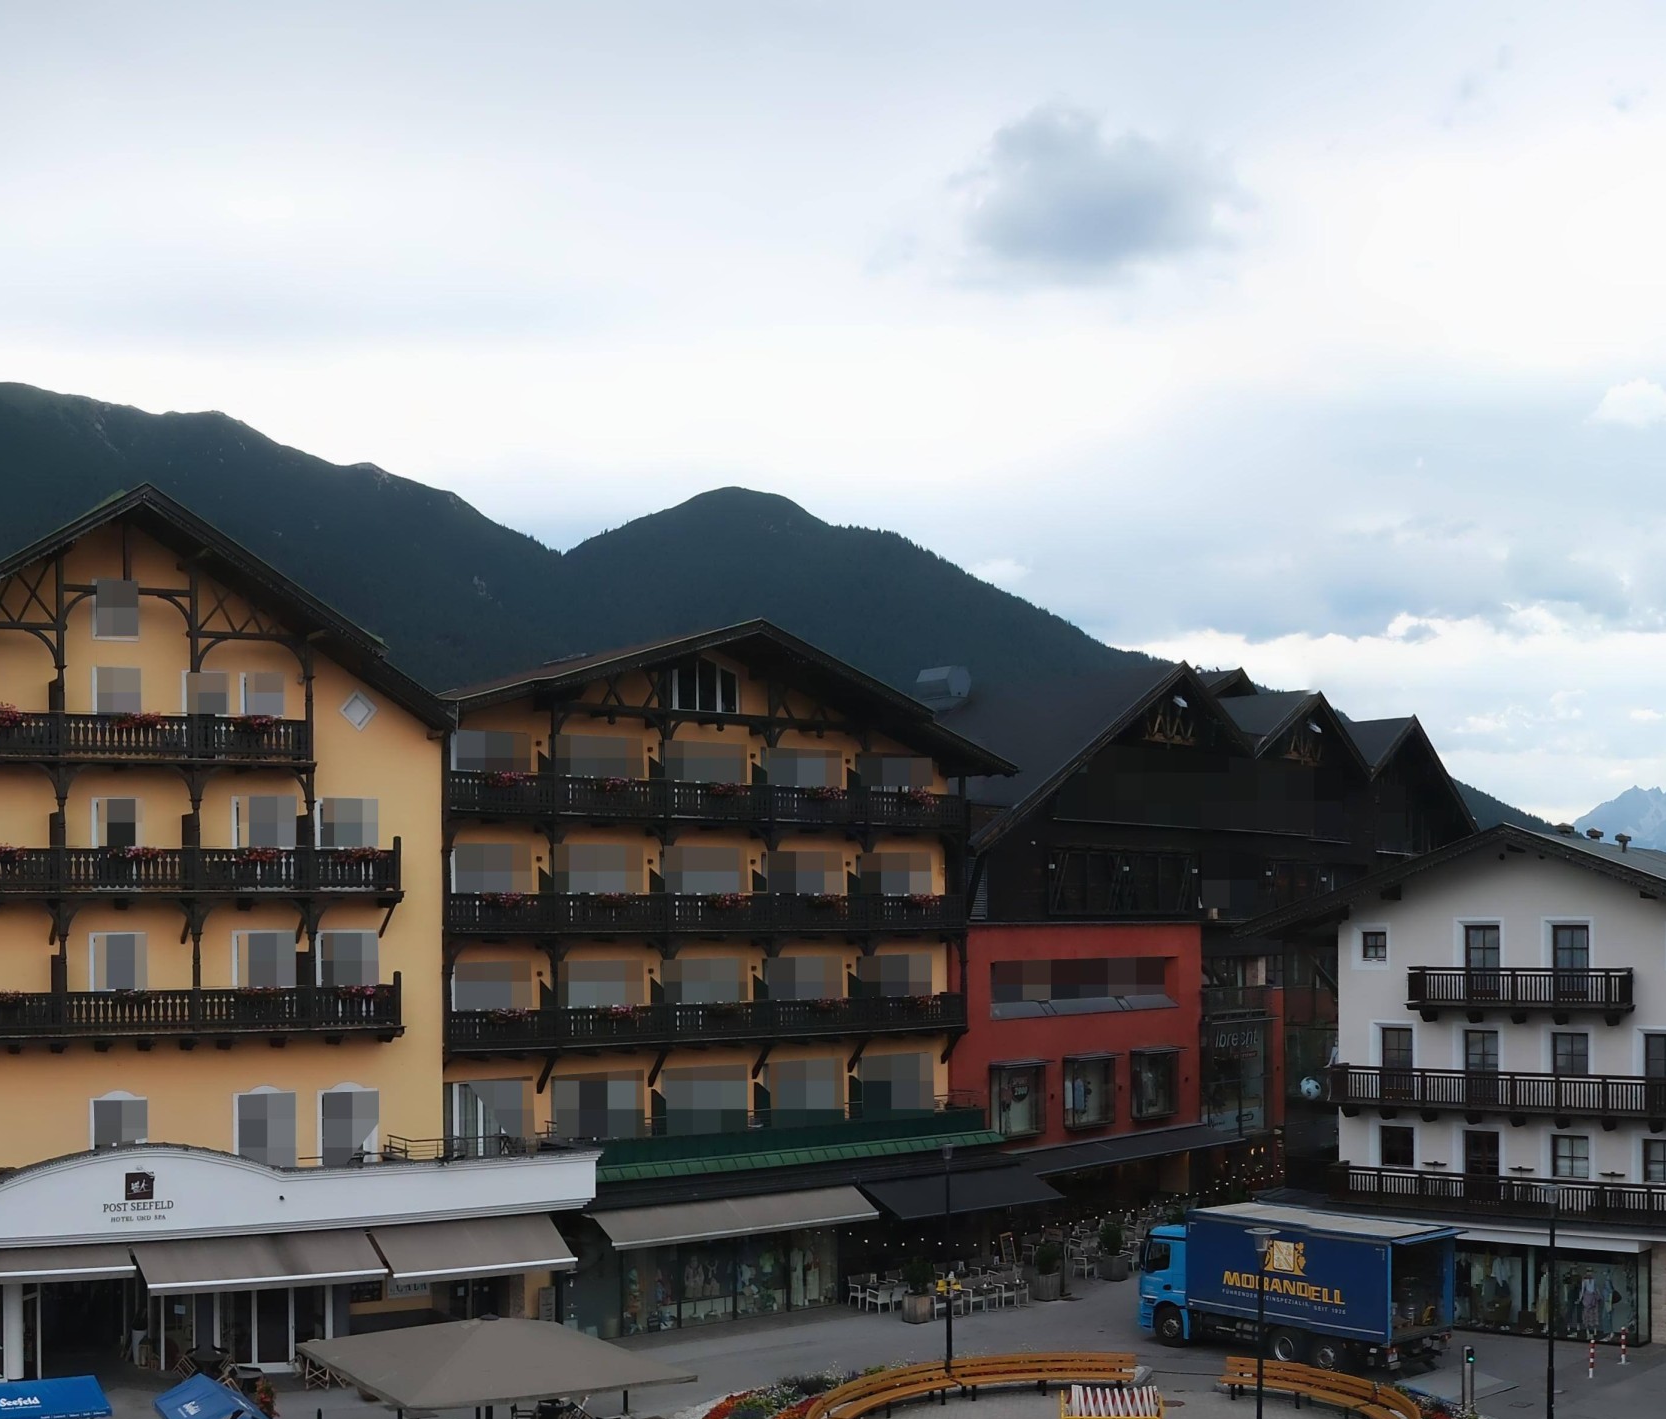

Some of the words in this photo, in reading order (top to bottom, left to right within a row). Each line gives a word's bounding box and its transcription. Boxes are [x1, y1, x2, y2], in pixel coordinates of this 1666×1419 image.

[103, 1203, 129, 1213] POST
[131, 1200, 174, 1212] SEEFELD
[1260, 1294, 1310, 1308] EINSPEZIALIS
